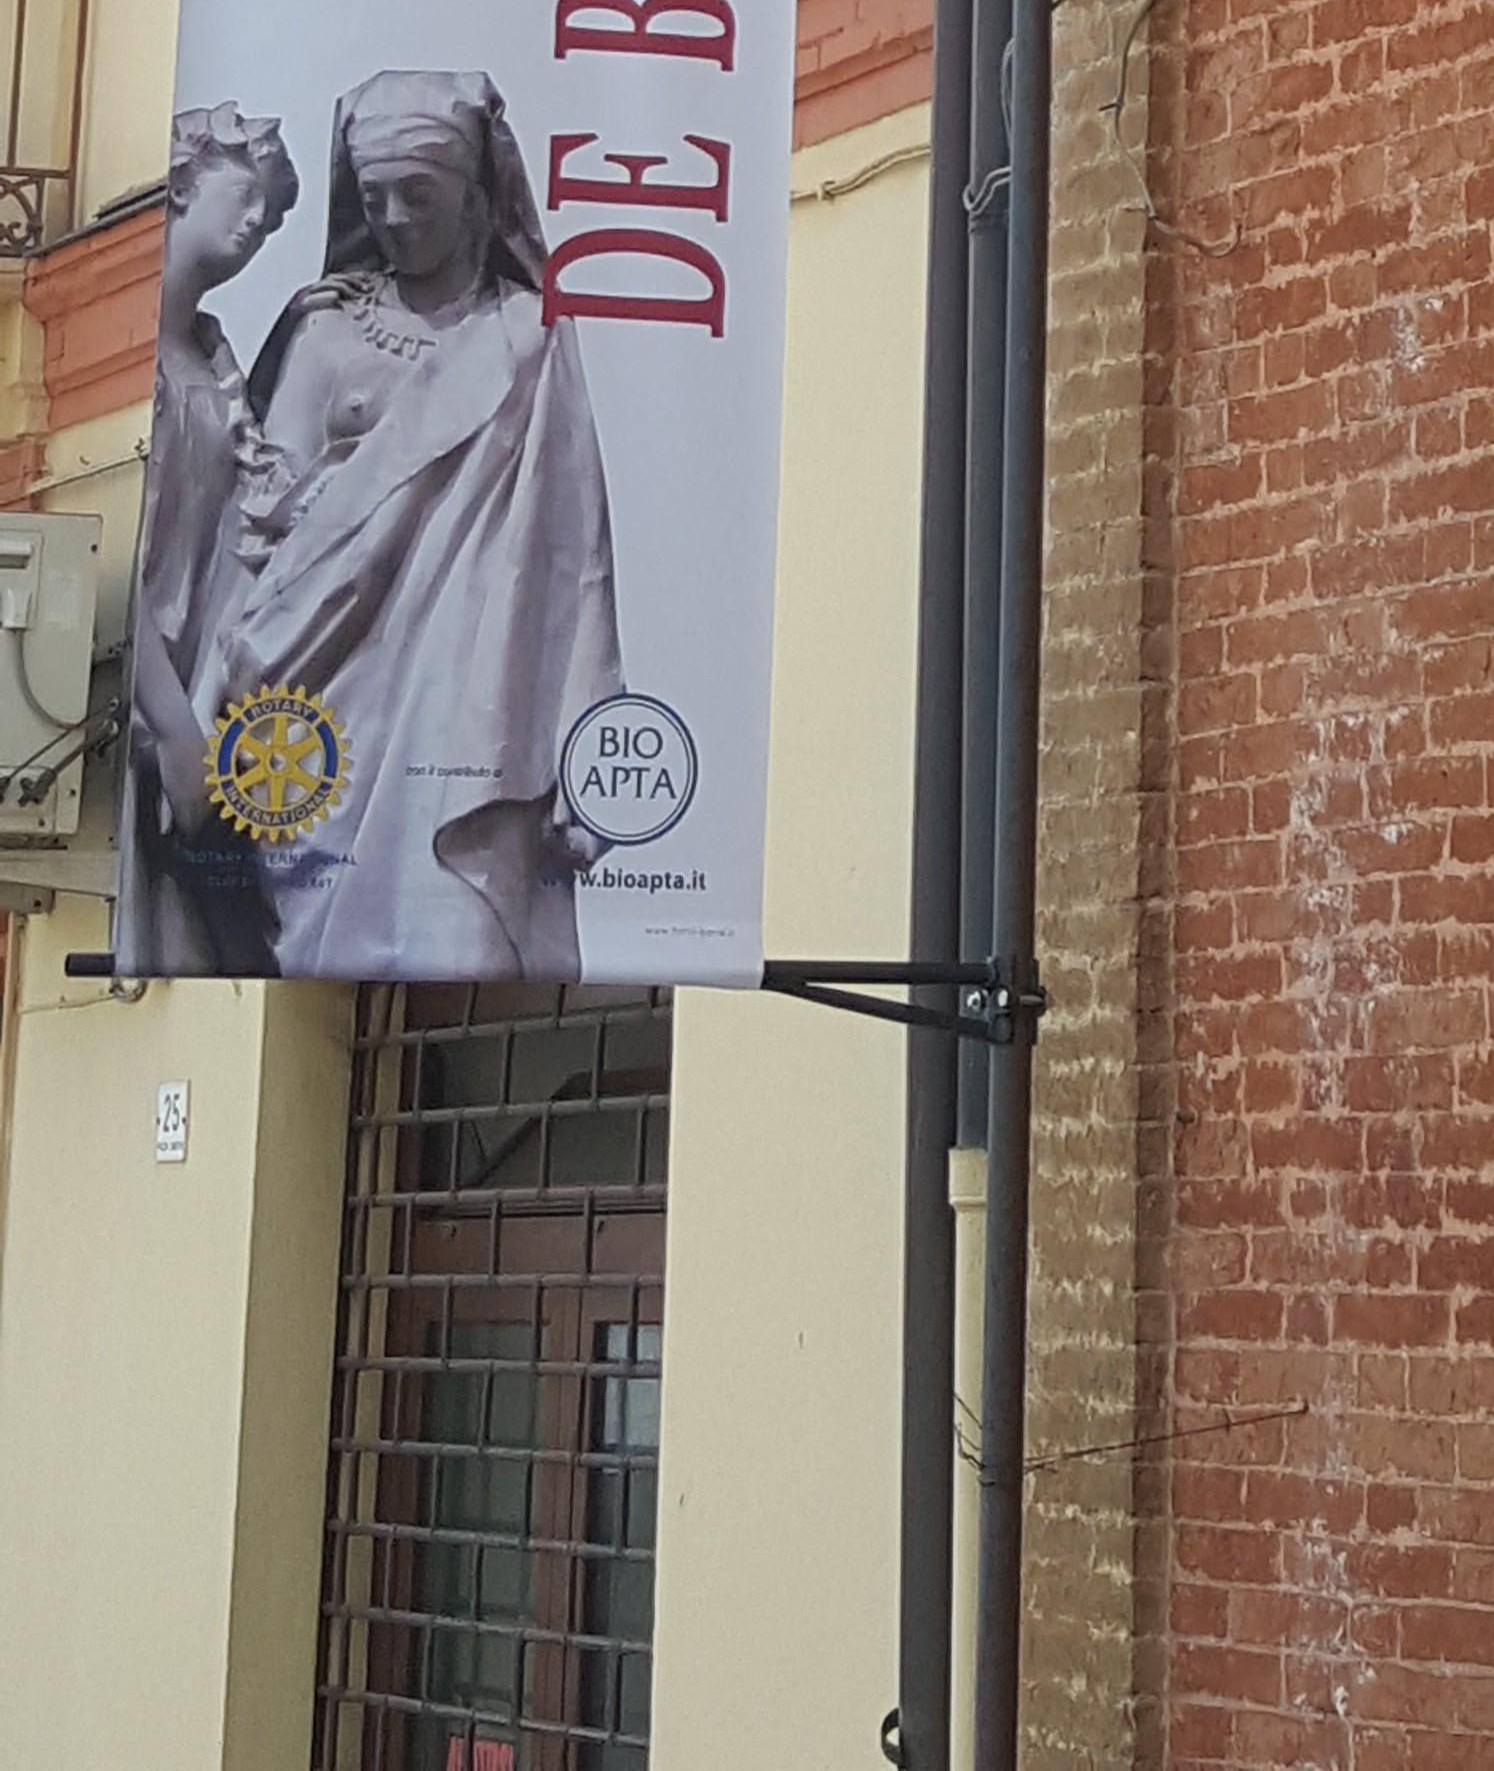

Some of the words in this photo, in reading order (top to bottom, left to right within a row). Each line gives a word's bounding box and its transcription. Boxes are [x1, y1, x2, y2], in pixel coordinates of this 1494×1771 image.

[541, 132, 735, 339] DE
[251, 700, 314, 718] ROTARY
[598, 726, 664, 760] BIO
[579, 765, 678, 800] APTA
[226, 787, 331, 826] INTERNATIONAL
[545, 866, 707, 895] w.bioapta.it
[162, 1093, 180, 1133] 25
